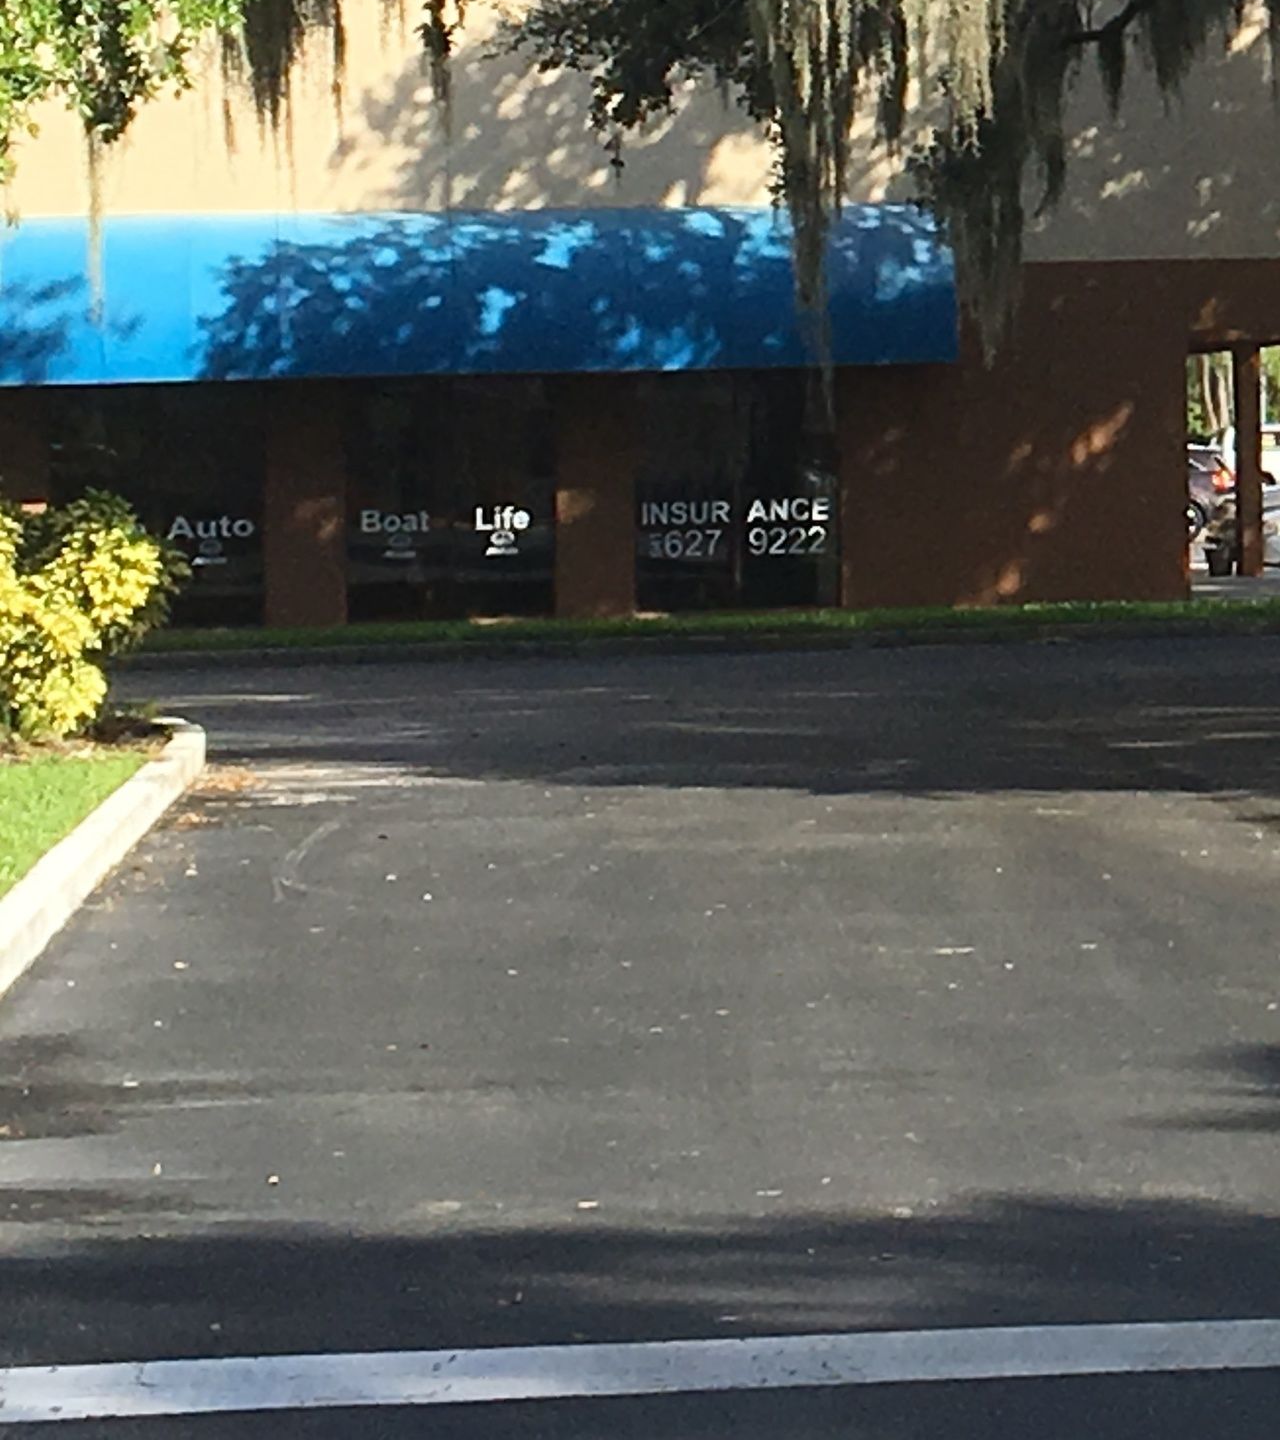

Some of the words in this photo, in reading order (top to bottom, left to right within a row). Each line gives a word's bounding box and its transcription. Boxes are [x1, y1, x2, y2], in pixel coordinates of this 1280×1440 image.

[166, 515, 255, 540] Auto
[360, 509, 431, 533] Boat
[474, 505, 531, 531] Life
[664, 529, 722, 558] 627
[748, 525, 827, 556] 9222
